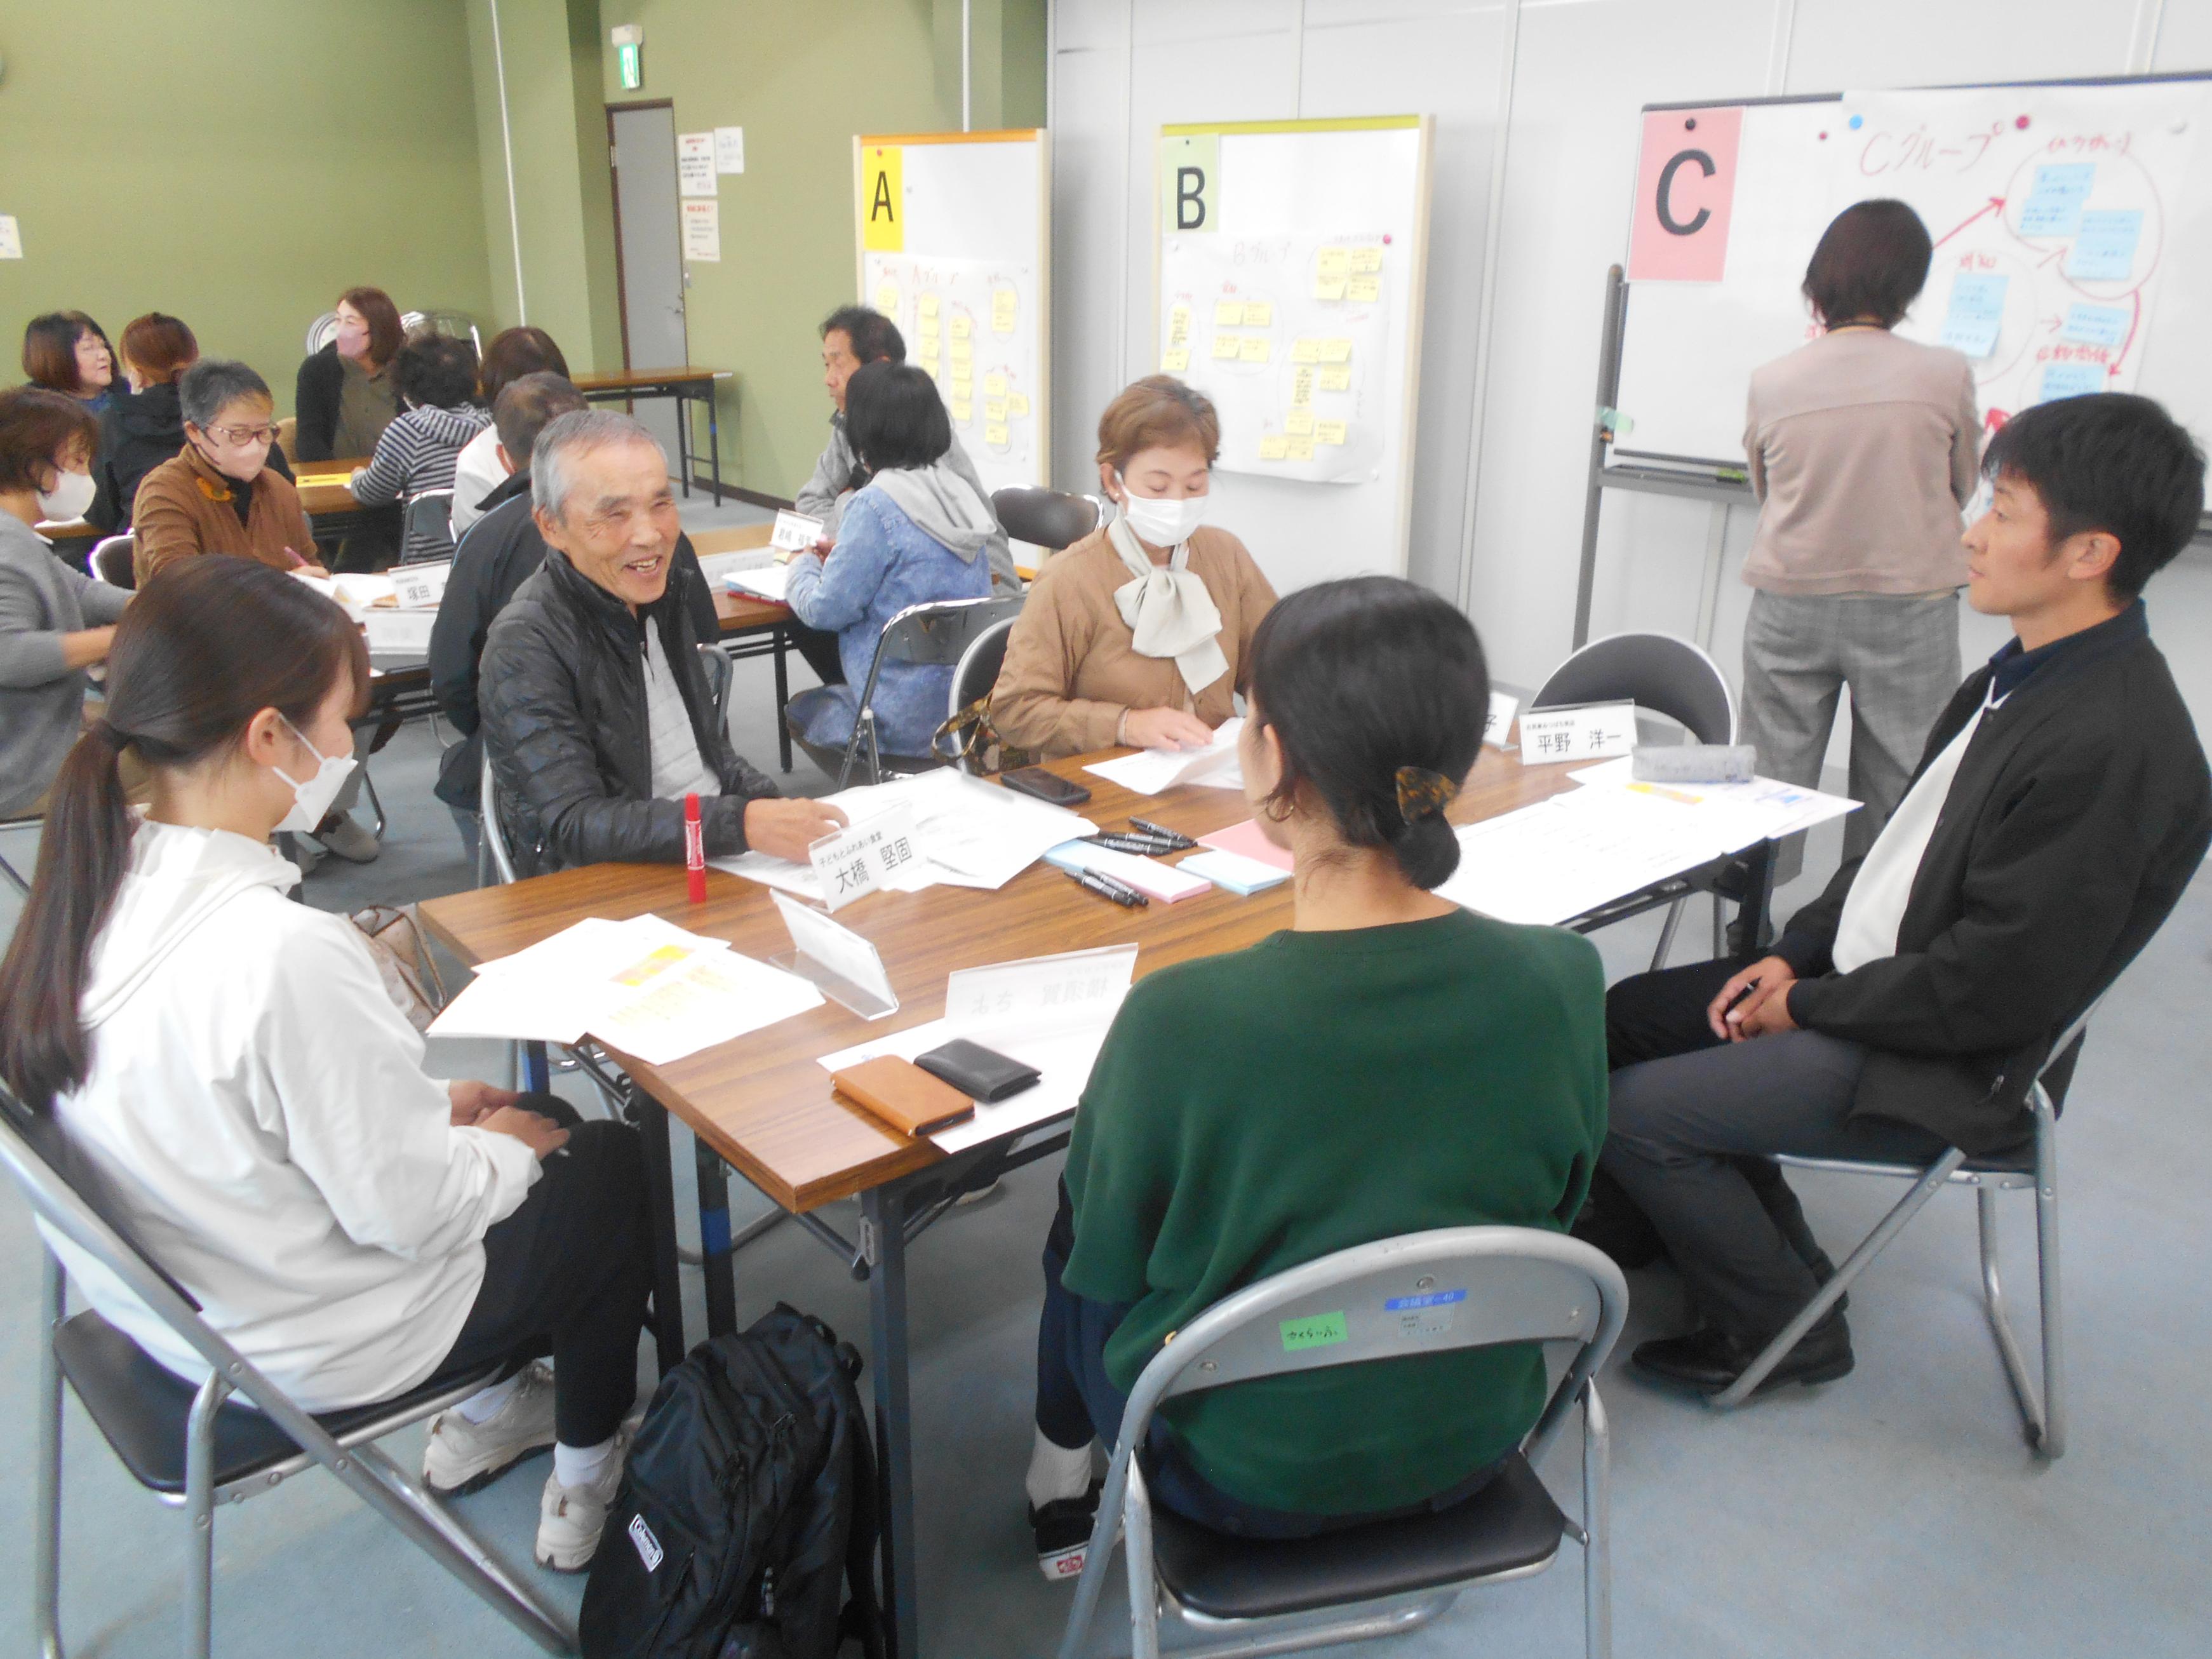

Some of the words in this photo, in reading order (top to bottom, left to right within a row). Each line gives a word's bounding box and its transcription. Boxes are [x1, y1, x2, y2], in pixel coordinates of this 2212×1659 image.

[1860, 120, 2005, 176] Cグループ
[871, 171, 894, 222] A
[1177, 166, 1206, 230] B
[1656, 149, 1716, 236] C
[1538, 731, 1571, 753] 平野
[1589, 729, 1622, 750] 洋一
[836, 858, 870, 894] 大橋
